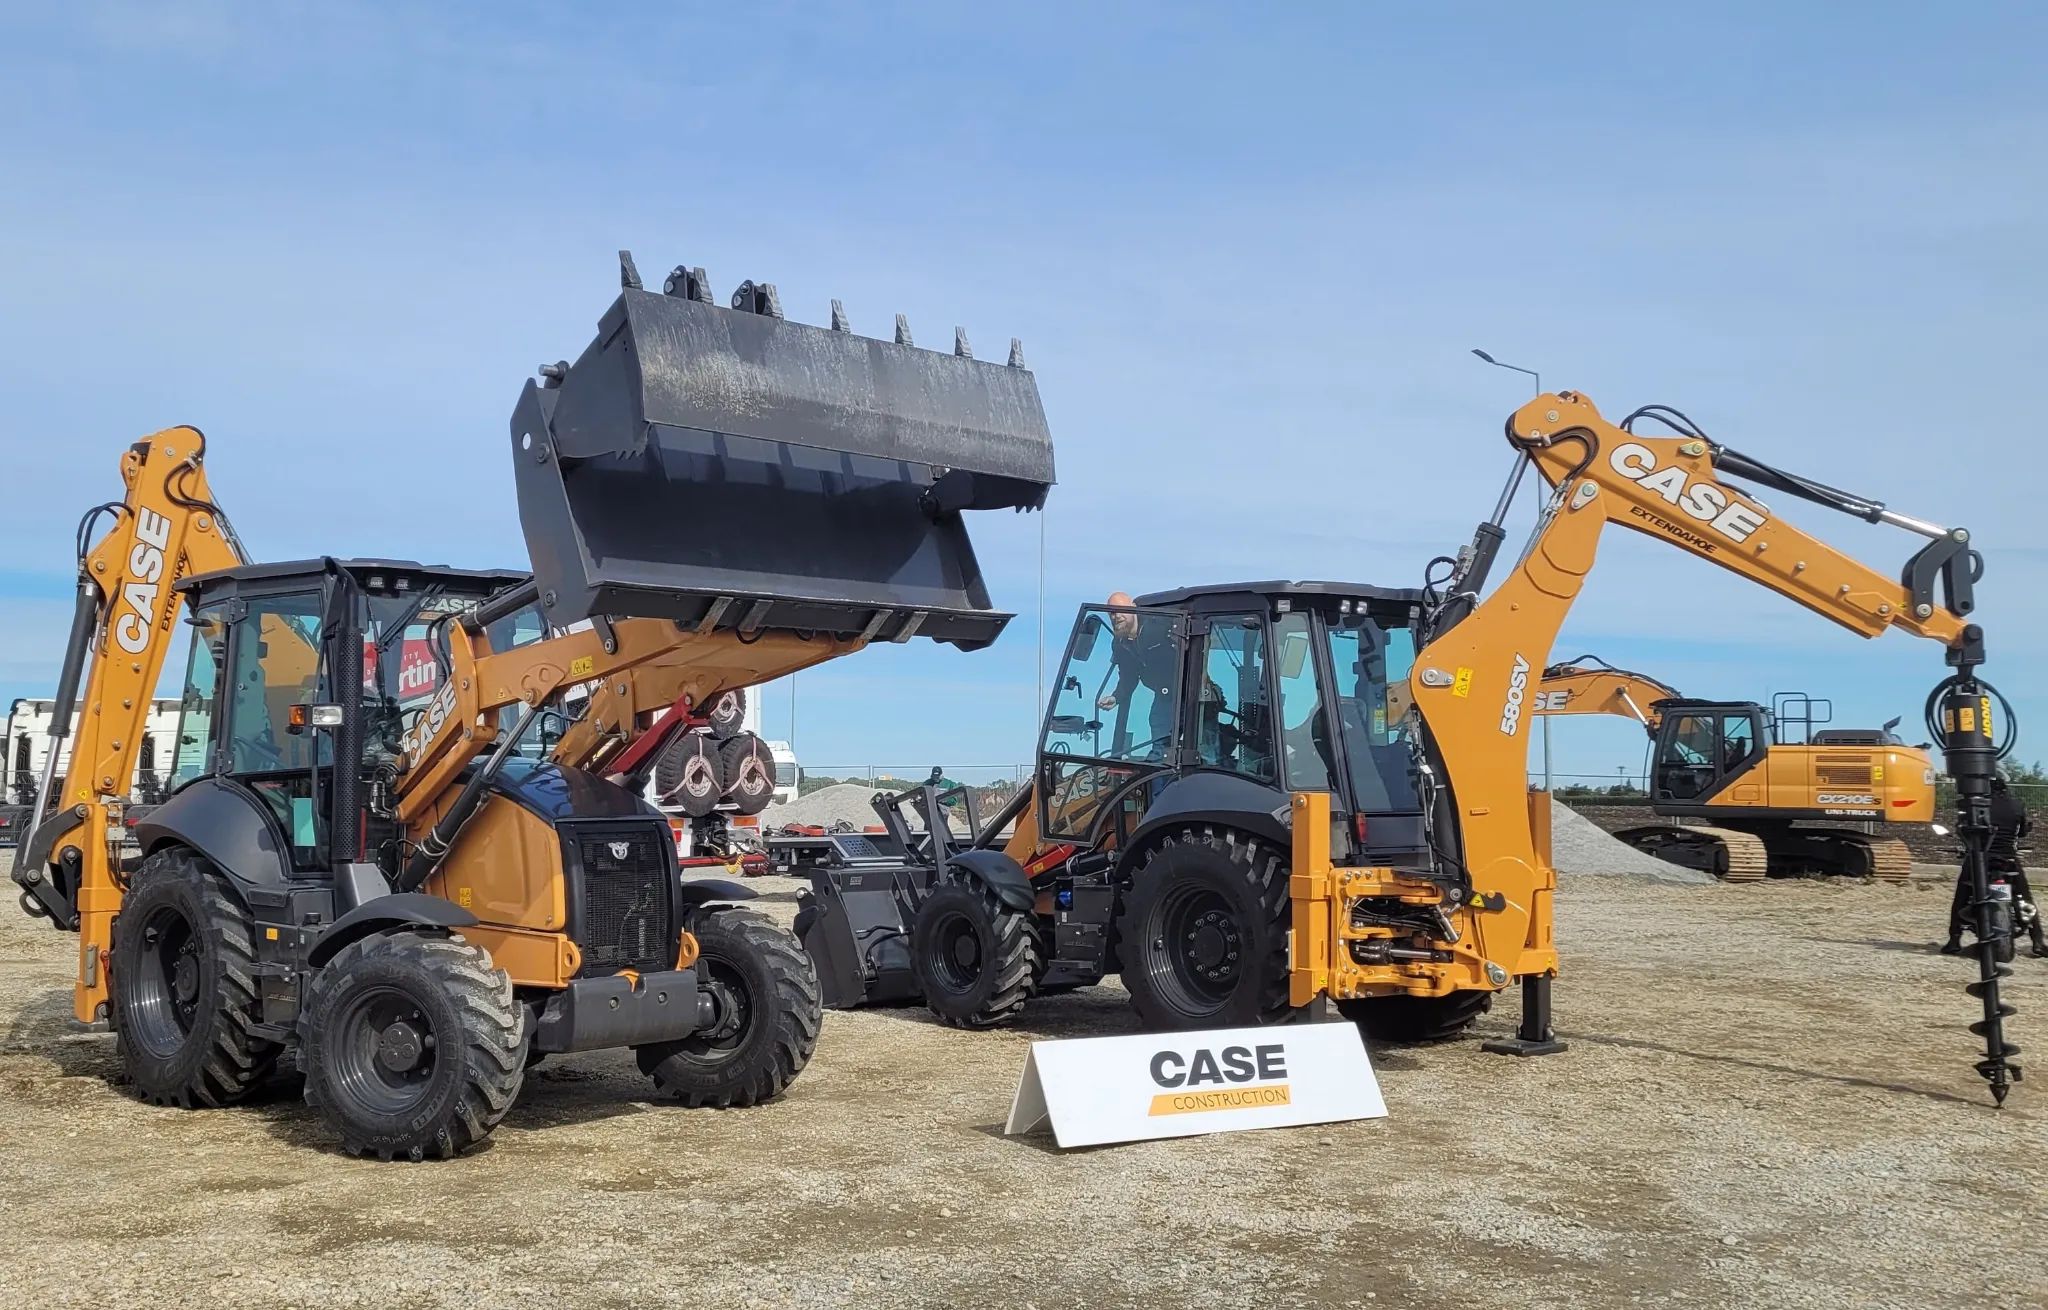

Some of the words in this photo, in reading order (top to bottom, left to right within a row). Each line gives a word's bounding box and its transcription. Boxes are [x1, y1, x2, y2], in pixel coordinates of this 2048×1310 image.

[1609, 442, 1768, 544] CASE
[1628, 505, 1719, 555] EXTENDAHOE
[115, 505, 172, 654] CASE
[161, 551, 188, 632] EXTENAHOE
[398, 658, 437, 693] rtin
[1499, 652, 1531, 737] 580SV
[1532, 690, 1569, 711] SE
[409, 681, 457, 769] CASE
[1150, 1044, 1288, 1089] CASE
[1173, 1088, 1288, 1111] CONSTRUCTION
